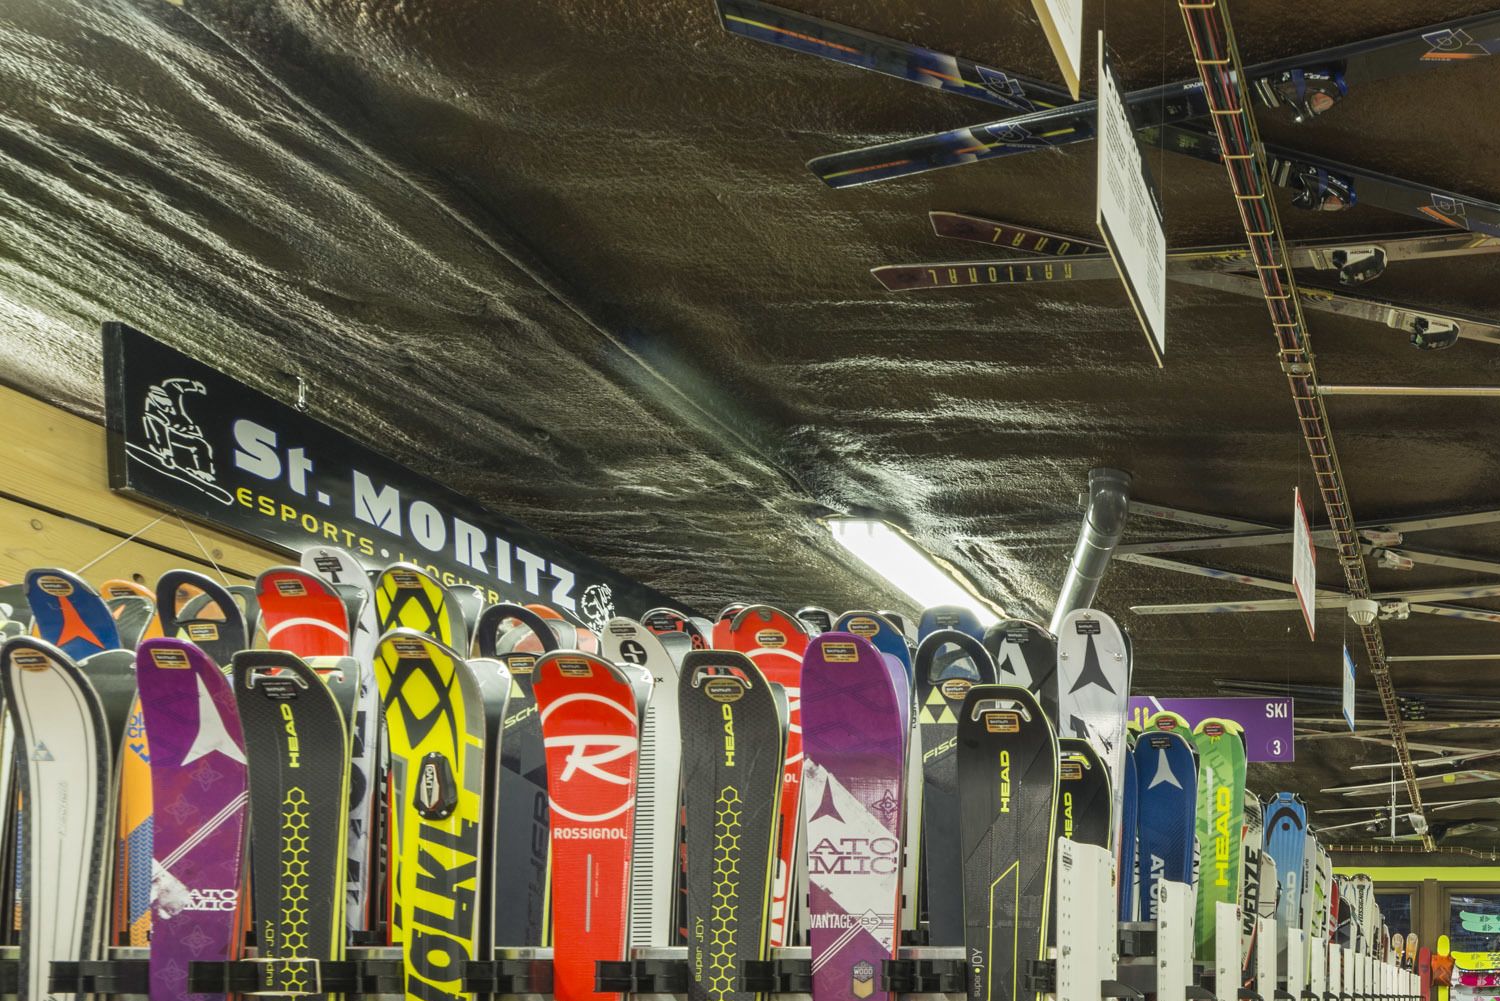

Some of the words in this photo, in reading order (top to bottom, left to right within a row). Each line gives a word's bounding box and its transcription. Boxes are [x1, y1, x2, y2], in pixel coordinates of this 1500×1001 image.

[927, 262, 1073, 285] NATIONAL
[232, 418, 332, 507] St.
[353, 468, 577, 612] MORITZ
[235, 486, 375, 557] ESPORTS
[1265, 702, 1289, 719] SKI
[280, 703, 301, 769] HEAD
[721, 703, 736, 768] HEAD
[1272, 739, 1282, 756] 3
[999, 749, 1011, 814] HEAD
[552, 826, 628, 841] ROSSIGNOL
[809, 836, 900, 856] ATO
[1215, 784, 1231, 888] HEAD
[808, 855, 898, 875] MIC
[264, 919, 275, 947] JOY
[694, 915, 705, 943] JOY
[809, 912, 852, 930] VANTAGE
[860, 916, 879, 926] 85
[694, 945, 704, 983] super
[971, 947, 985, 968] JOY
[973, 974, 982, 998] super
